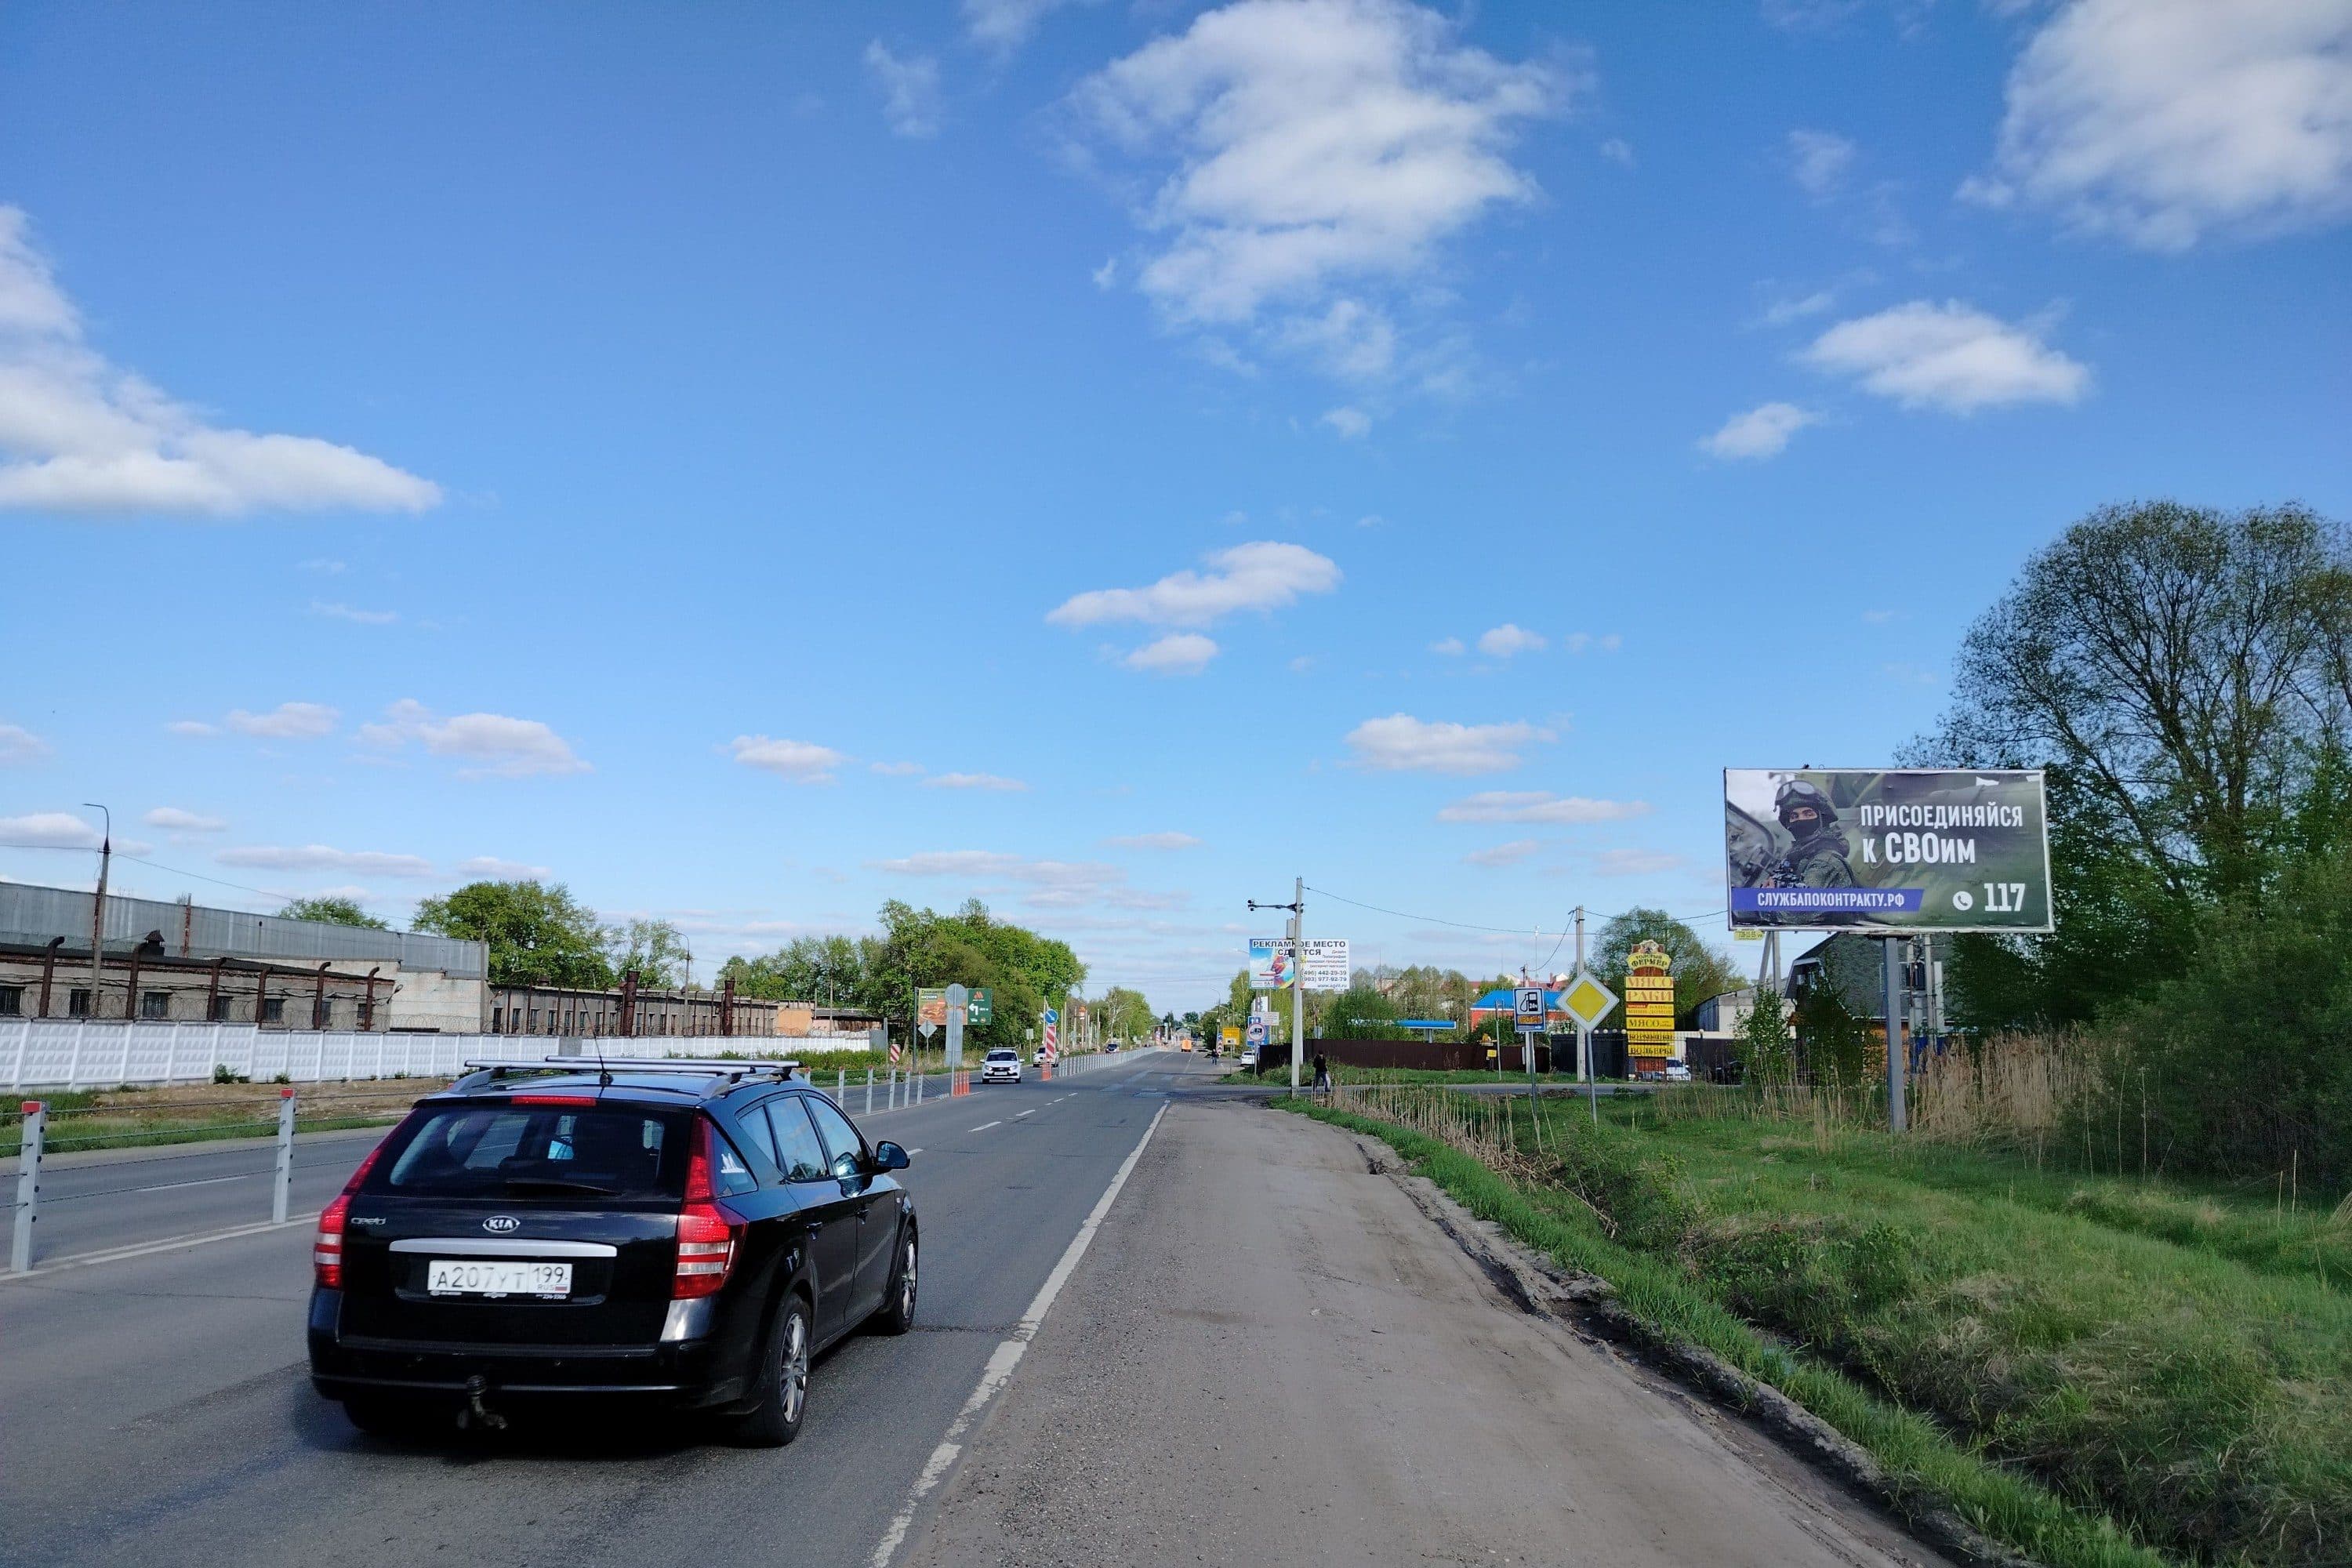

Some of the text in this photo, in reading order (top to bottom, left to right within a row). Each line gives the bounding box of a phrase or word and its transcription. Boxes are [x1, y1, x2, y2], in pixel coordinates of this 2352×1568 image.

[1860, 803, 2024, 829] ПРИСОЕДИНЯЙСЯ
[1863, 838, 1878, 863] К
[1757, 892, 1905, 908] СЛУЖБАПОКОНТРАКТУ.РФ
[1984, 883, 2025, 912] 117
[1628, 977, 1672, 987] МЯСО
[1628, 991, 1671, 1001] РАКИ
[1629, 1018, 1660, 1028] МЯСО
[488, 1219, 513, 1229] KIA
[533, 1266, 564, 1283] 199
